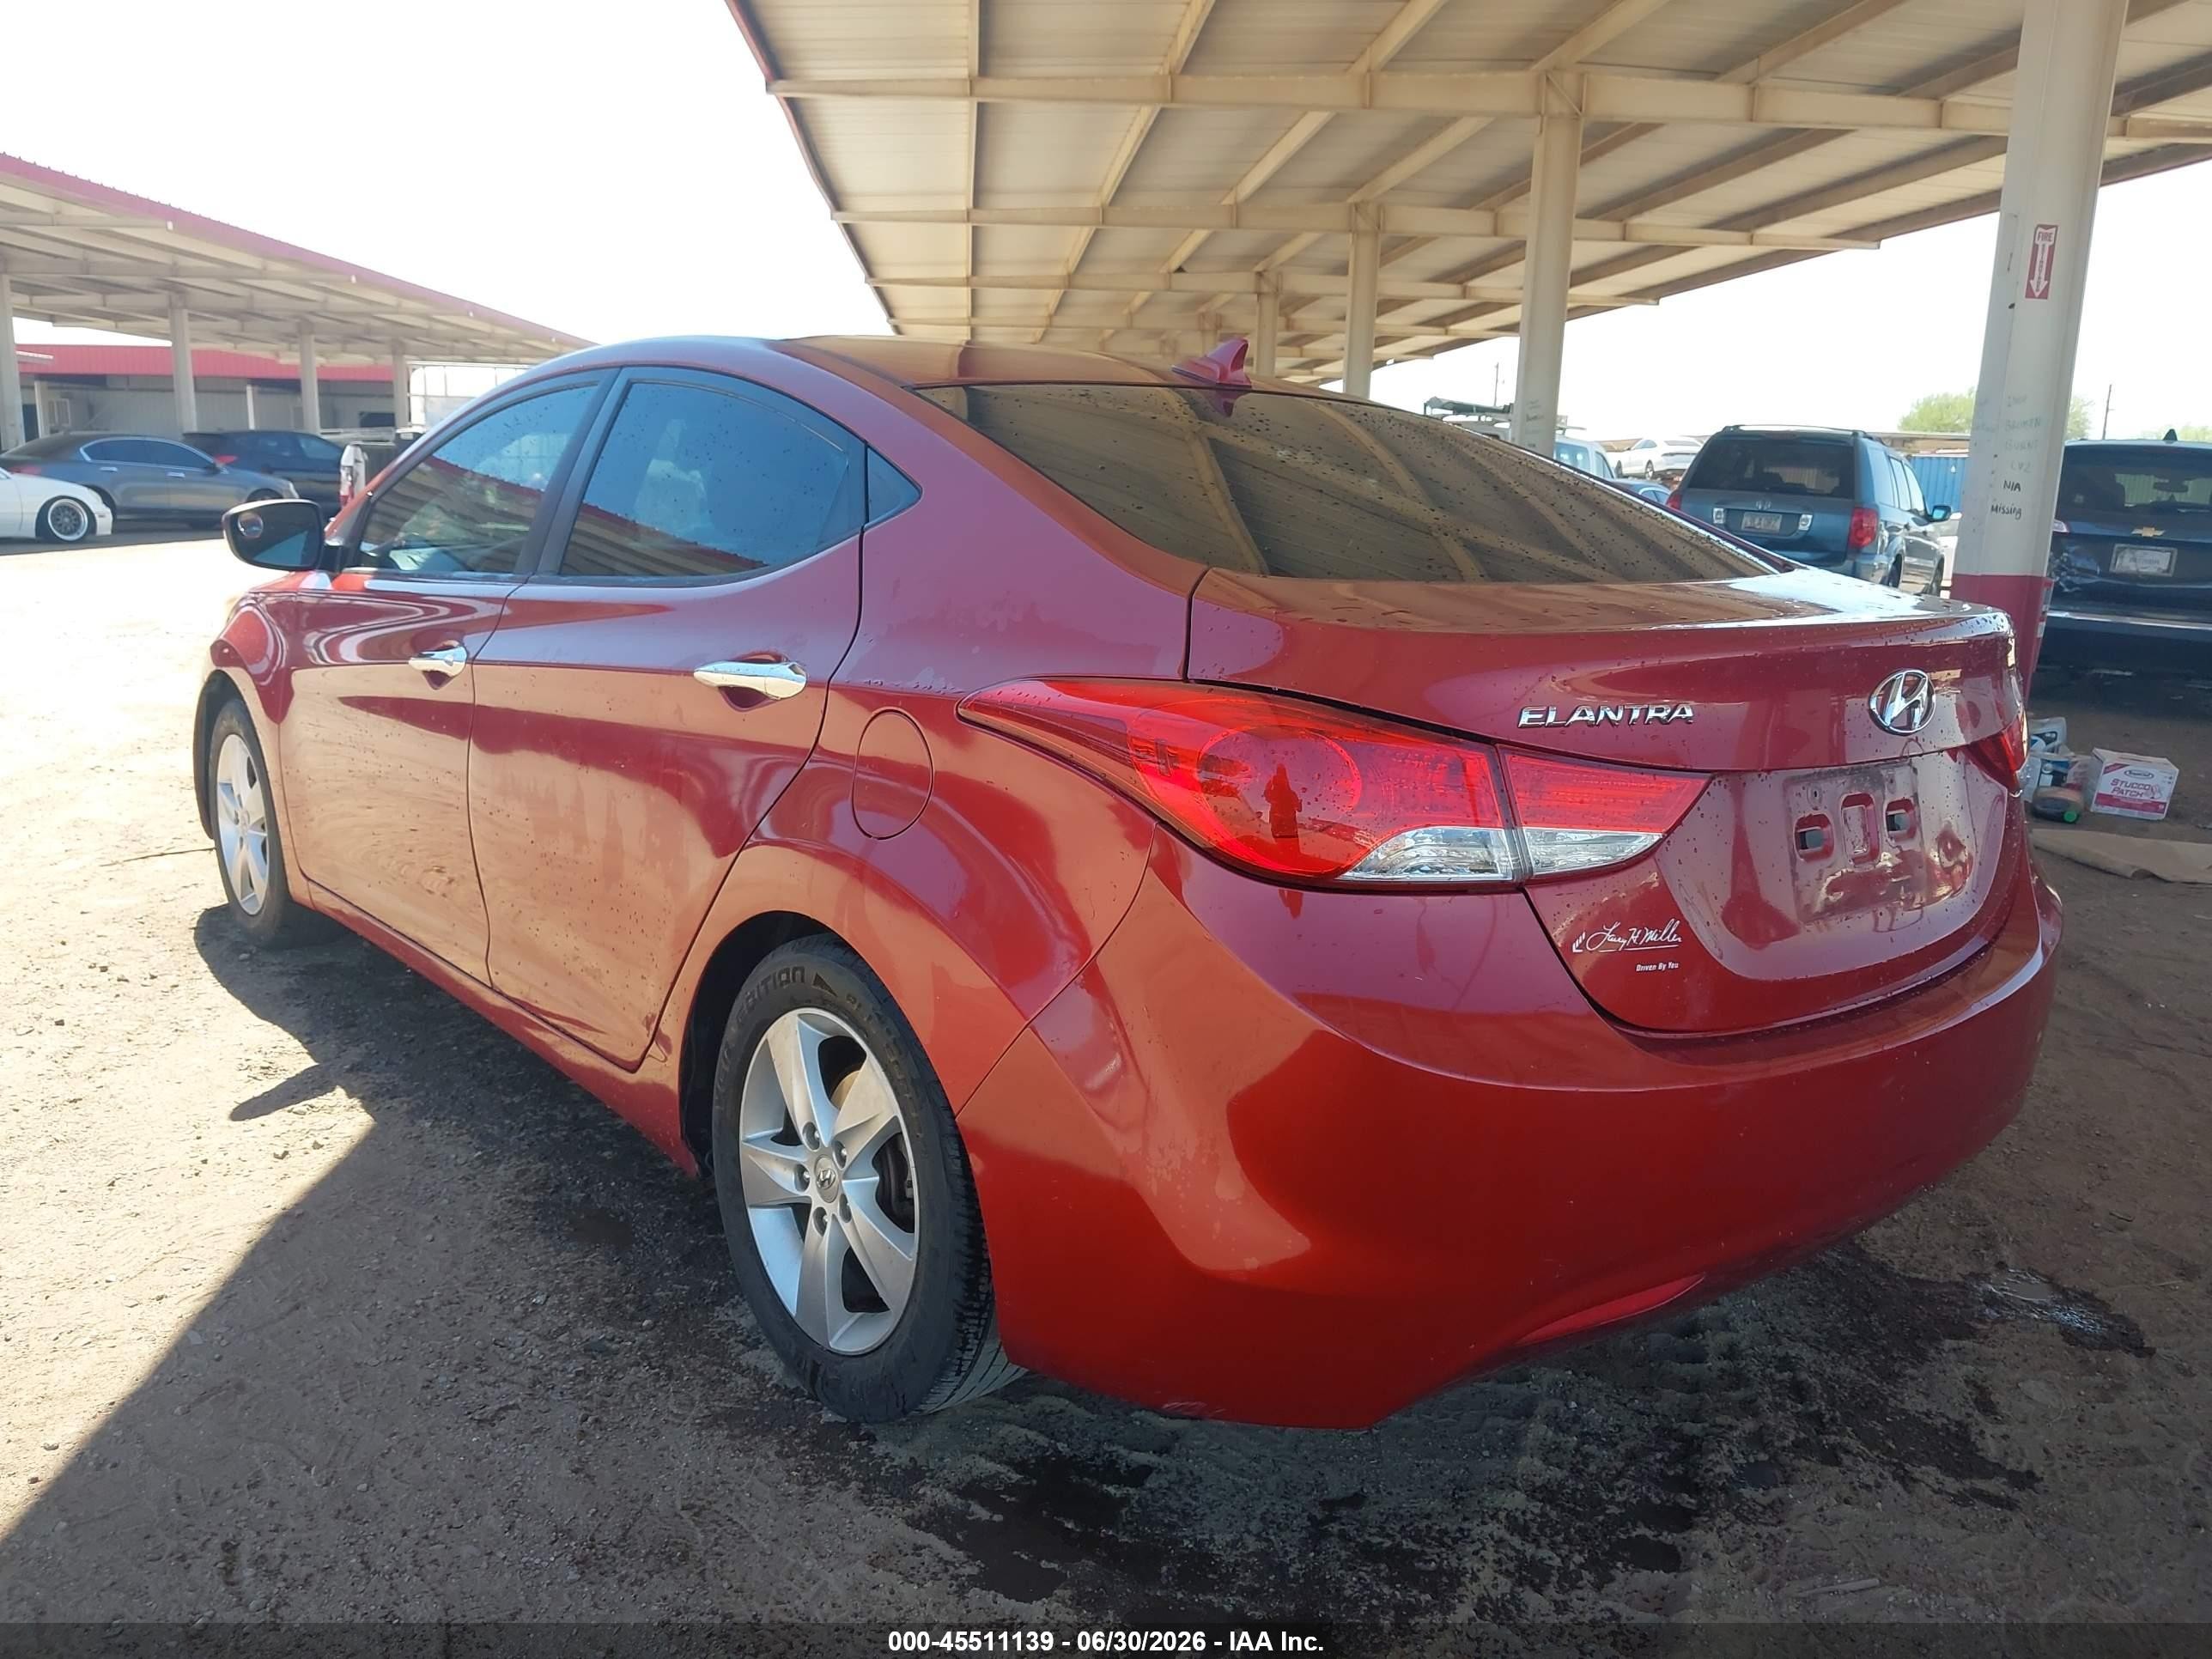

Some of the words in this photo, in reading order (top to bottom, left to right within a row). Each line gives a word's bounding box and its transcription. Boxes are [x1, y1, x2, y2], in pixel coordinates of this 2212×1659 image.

[2038, 232, 2053, 242] FIRE
[1517, 704, 1693, 728] ELANTRA
[2110, 778, 2151, 791] STUCCO
[2111, 787, 2144, 798] PATCH
[1639, 918, 1682, 945] Miller
[1635, 963, 1656, 972] Driven
[1658, 962, 1667, 971] By
[1668, 961, 1680, 969] You
